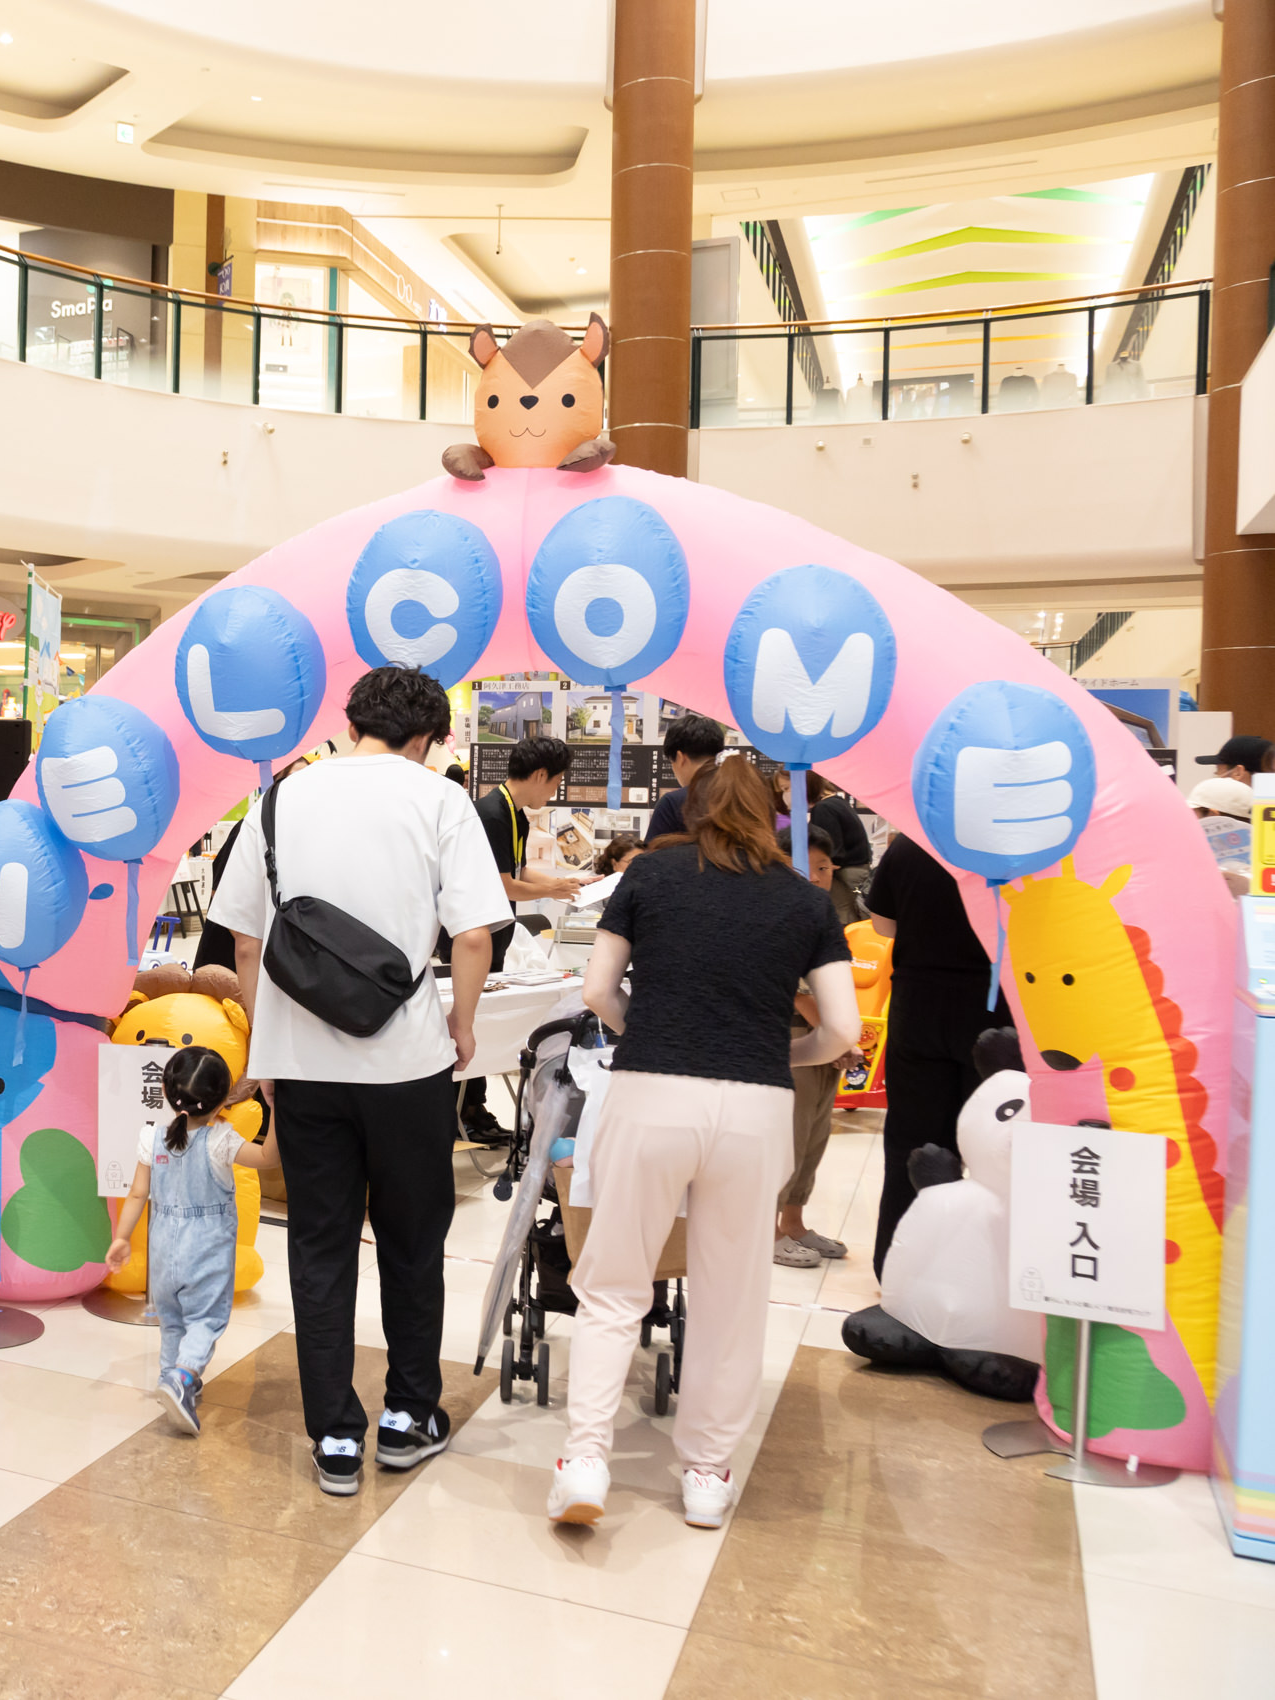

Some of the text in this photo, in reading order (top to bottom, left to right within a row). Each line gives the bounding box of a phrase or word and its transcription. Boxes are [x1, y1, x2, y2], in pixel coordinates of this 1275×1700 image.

[50, 297, 113, 319] SmaPa
[141, 1061, 165, 1110] 会場
[1069, 1146, 1102, 1282] 会場 入口
[581, 1457, 598, 1469] NY
[693, 1476, 711, 1488] NY
